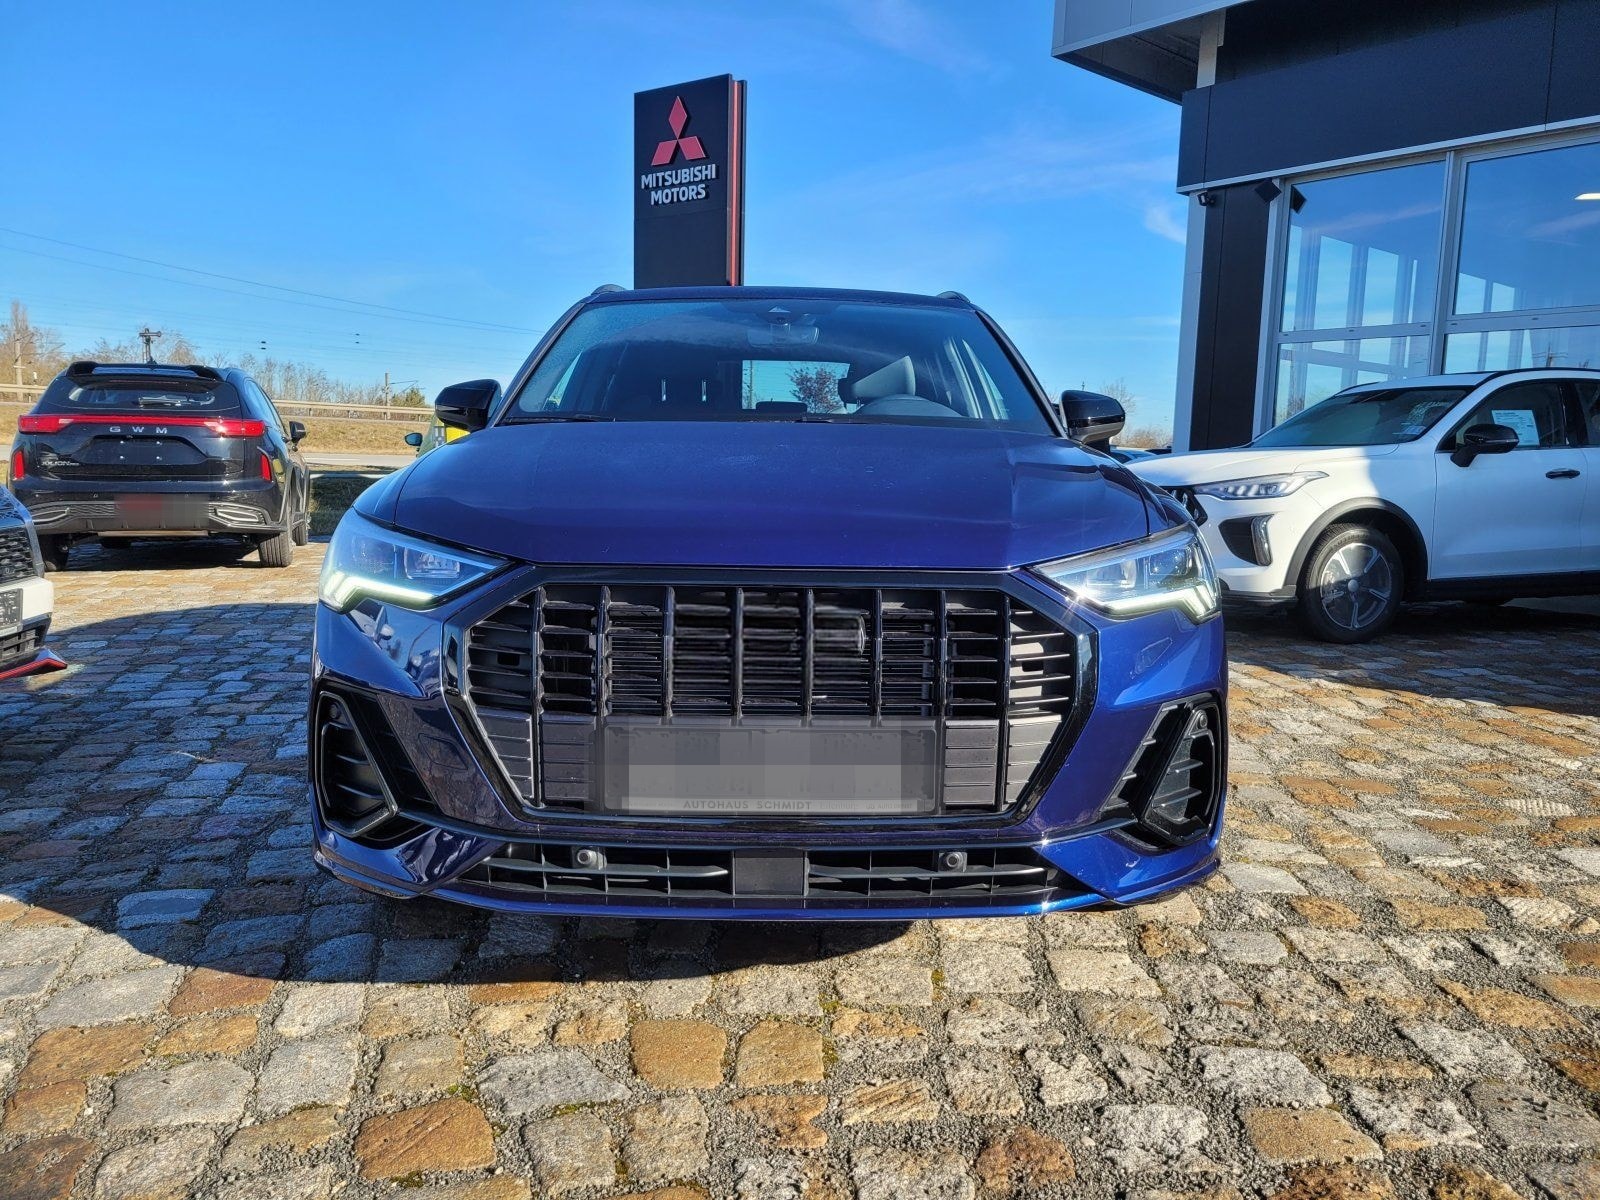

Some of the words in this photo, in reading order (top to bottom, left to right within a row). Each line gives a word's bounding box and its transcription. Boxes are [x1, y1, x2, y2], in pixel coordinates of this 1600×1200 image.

[641, 163, 716, 189] MITSUBISHI
[650, 183, 706, 206] MOTORS
[109, 425, 168, 434] GWM
[683, 800, 749, 809] AUTOHAUS
[756, 800, 812, 810] SCHMIDT
